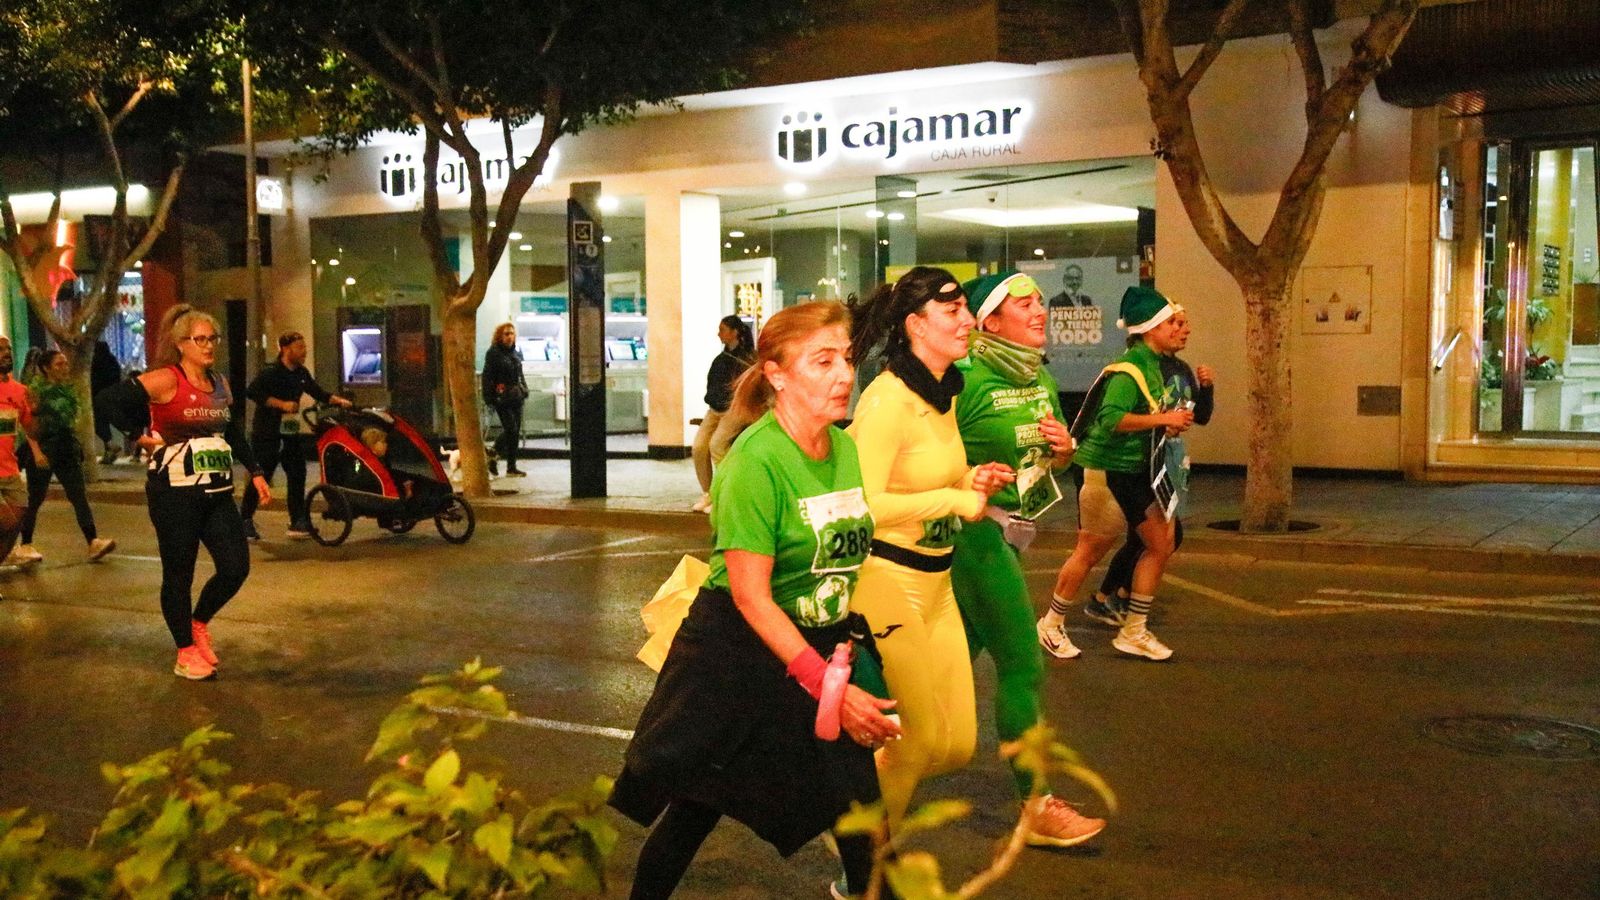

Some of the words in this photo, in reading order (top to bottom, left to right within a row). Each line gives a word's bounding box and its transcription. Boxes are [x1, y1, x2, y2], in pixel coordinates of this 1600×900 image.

[841, 107, 1021, 159] cajamar
[931, 147, 967, 162] CAJA
[972, 143, 1021, 159] RURAL
[1050, 321, 1064, 330] LO
[1066, 321, 1102, 330] TIENES
[1050, 330, 1103, 344] TODO
[197, 454, 230, 468] 1010
[830, 527, 868, 560] 288
